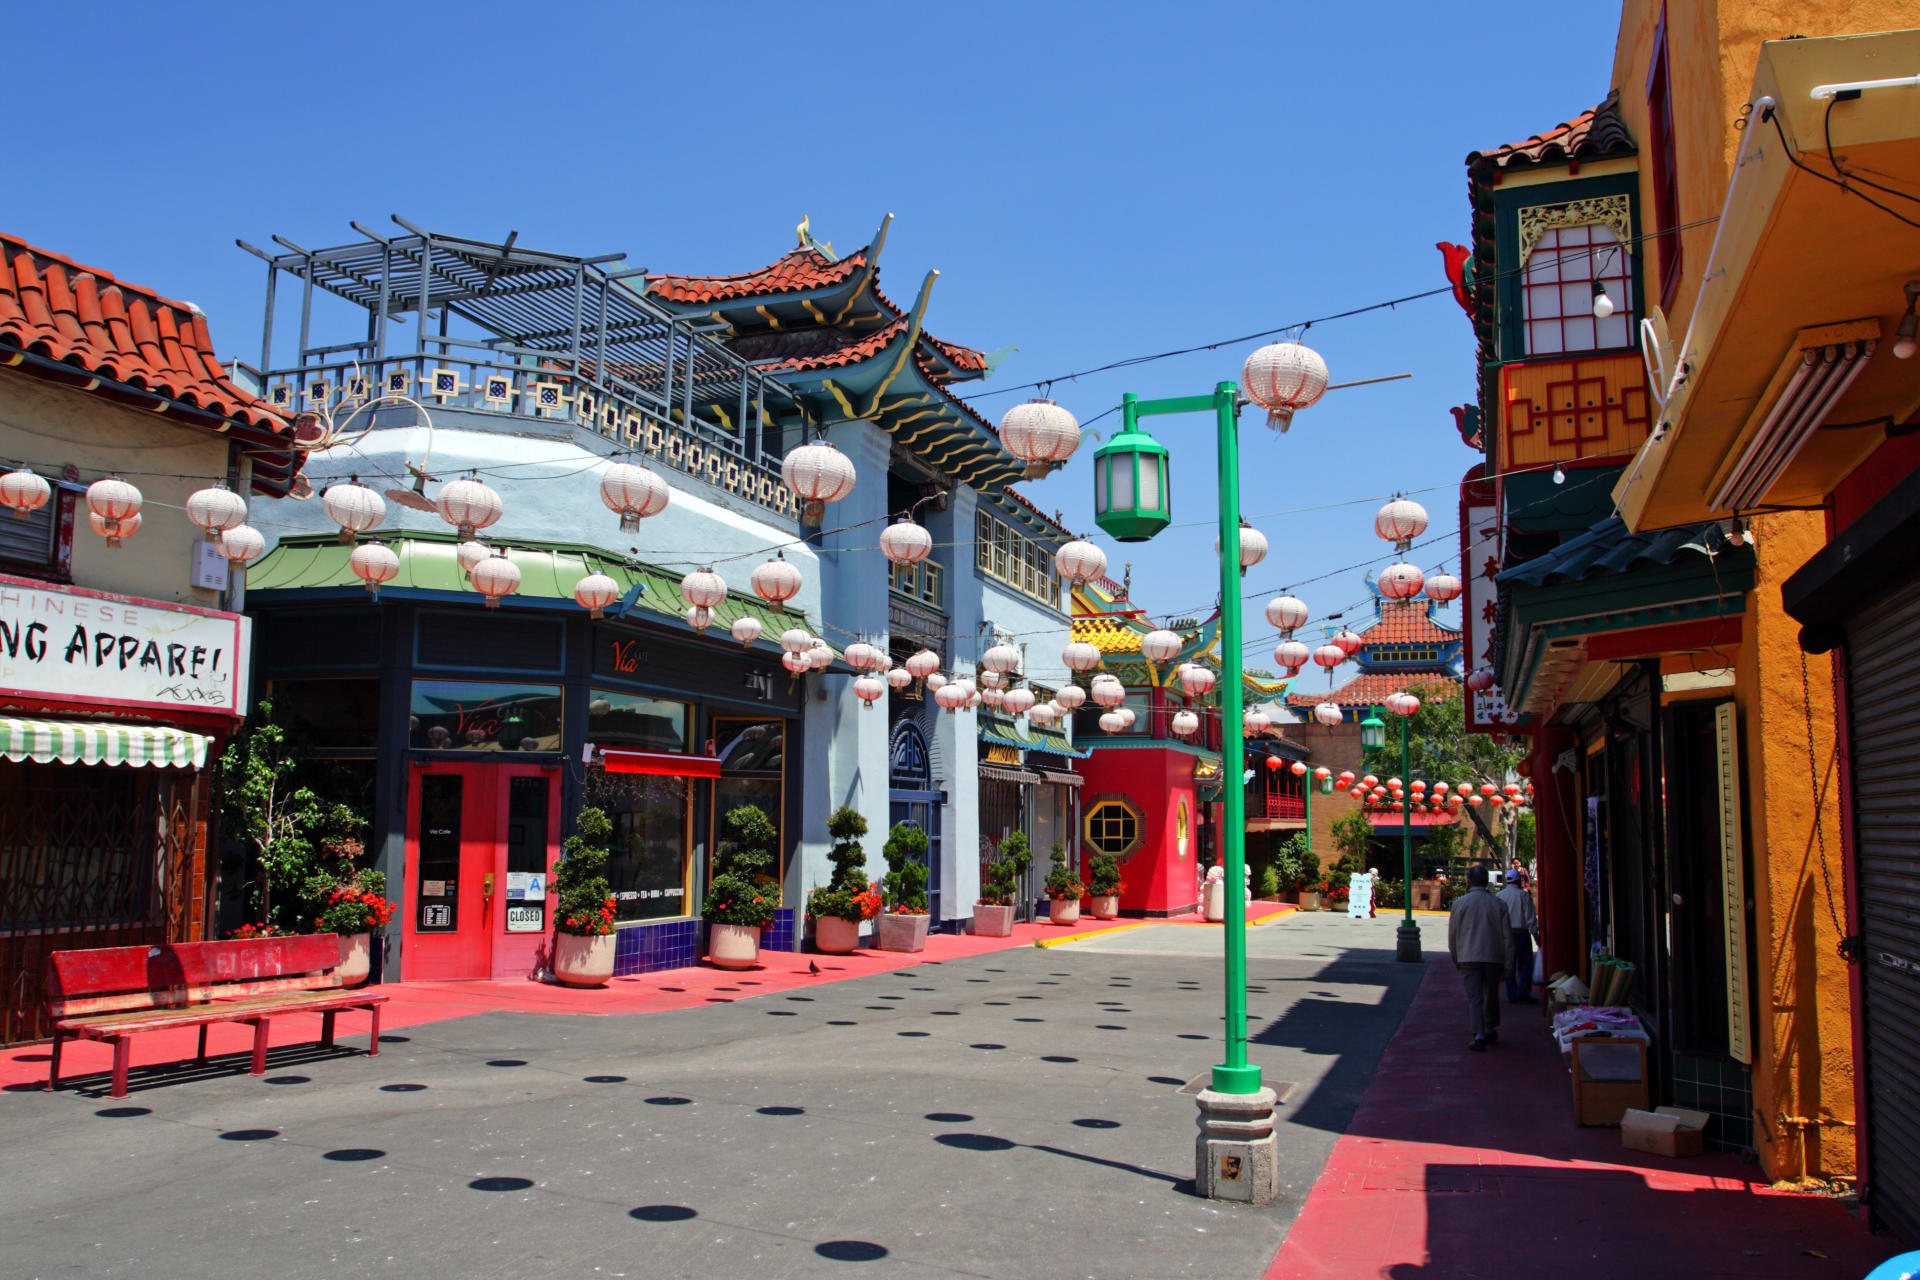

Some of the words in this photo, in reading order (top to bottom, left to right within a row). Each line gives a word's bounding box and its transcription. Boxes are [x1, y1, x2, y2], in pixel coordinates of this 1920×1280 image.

[64, 622, 227, 683] APPAREL
[611, 640, 639, 672] Via
[454, 698, 502, 735] Via
[530, 877, 541, 891] A
[510, 911, 540, 922] CLOSED
